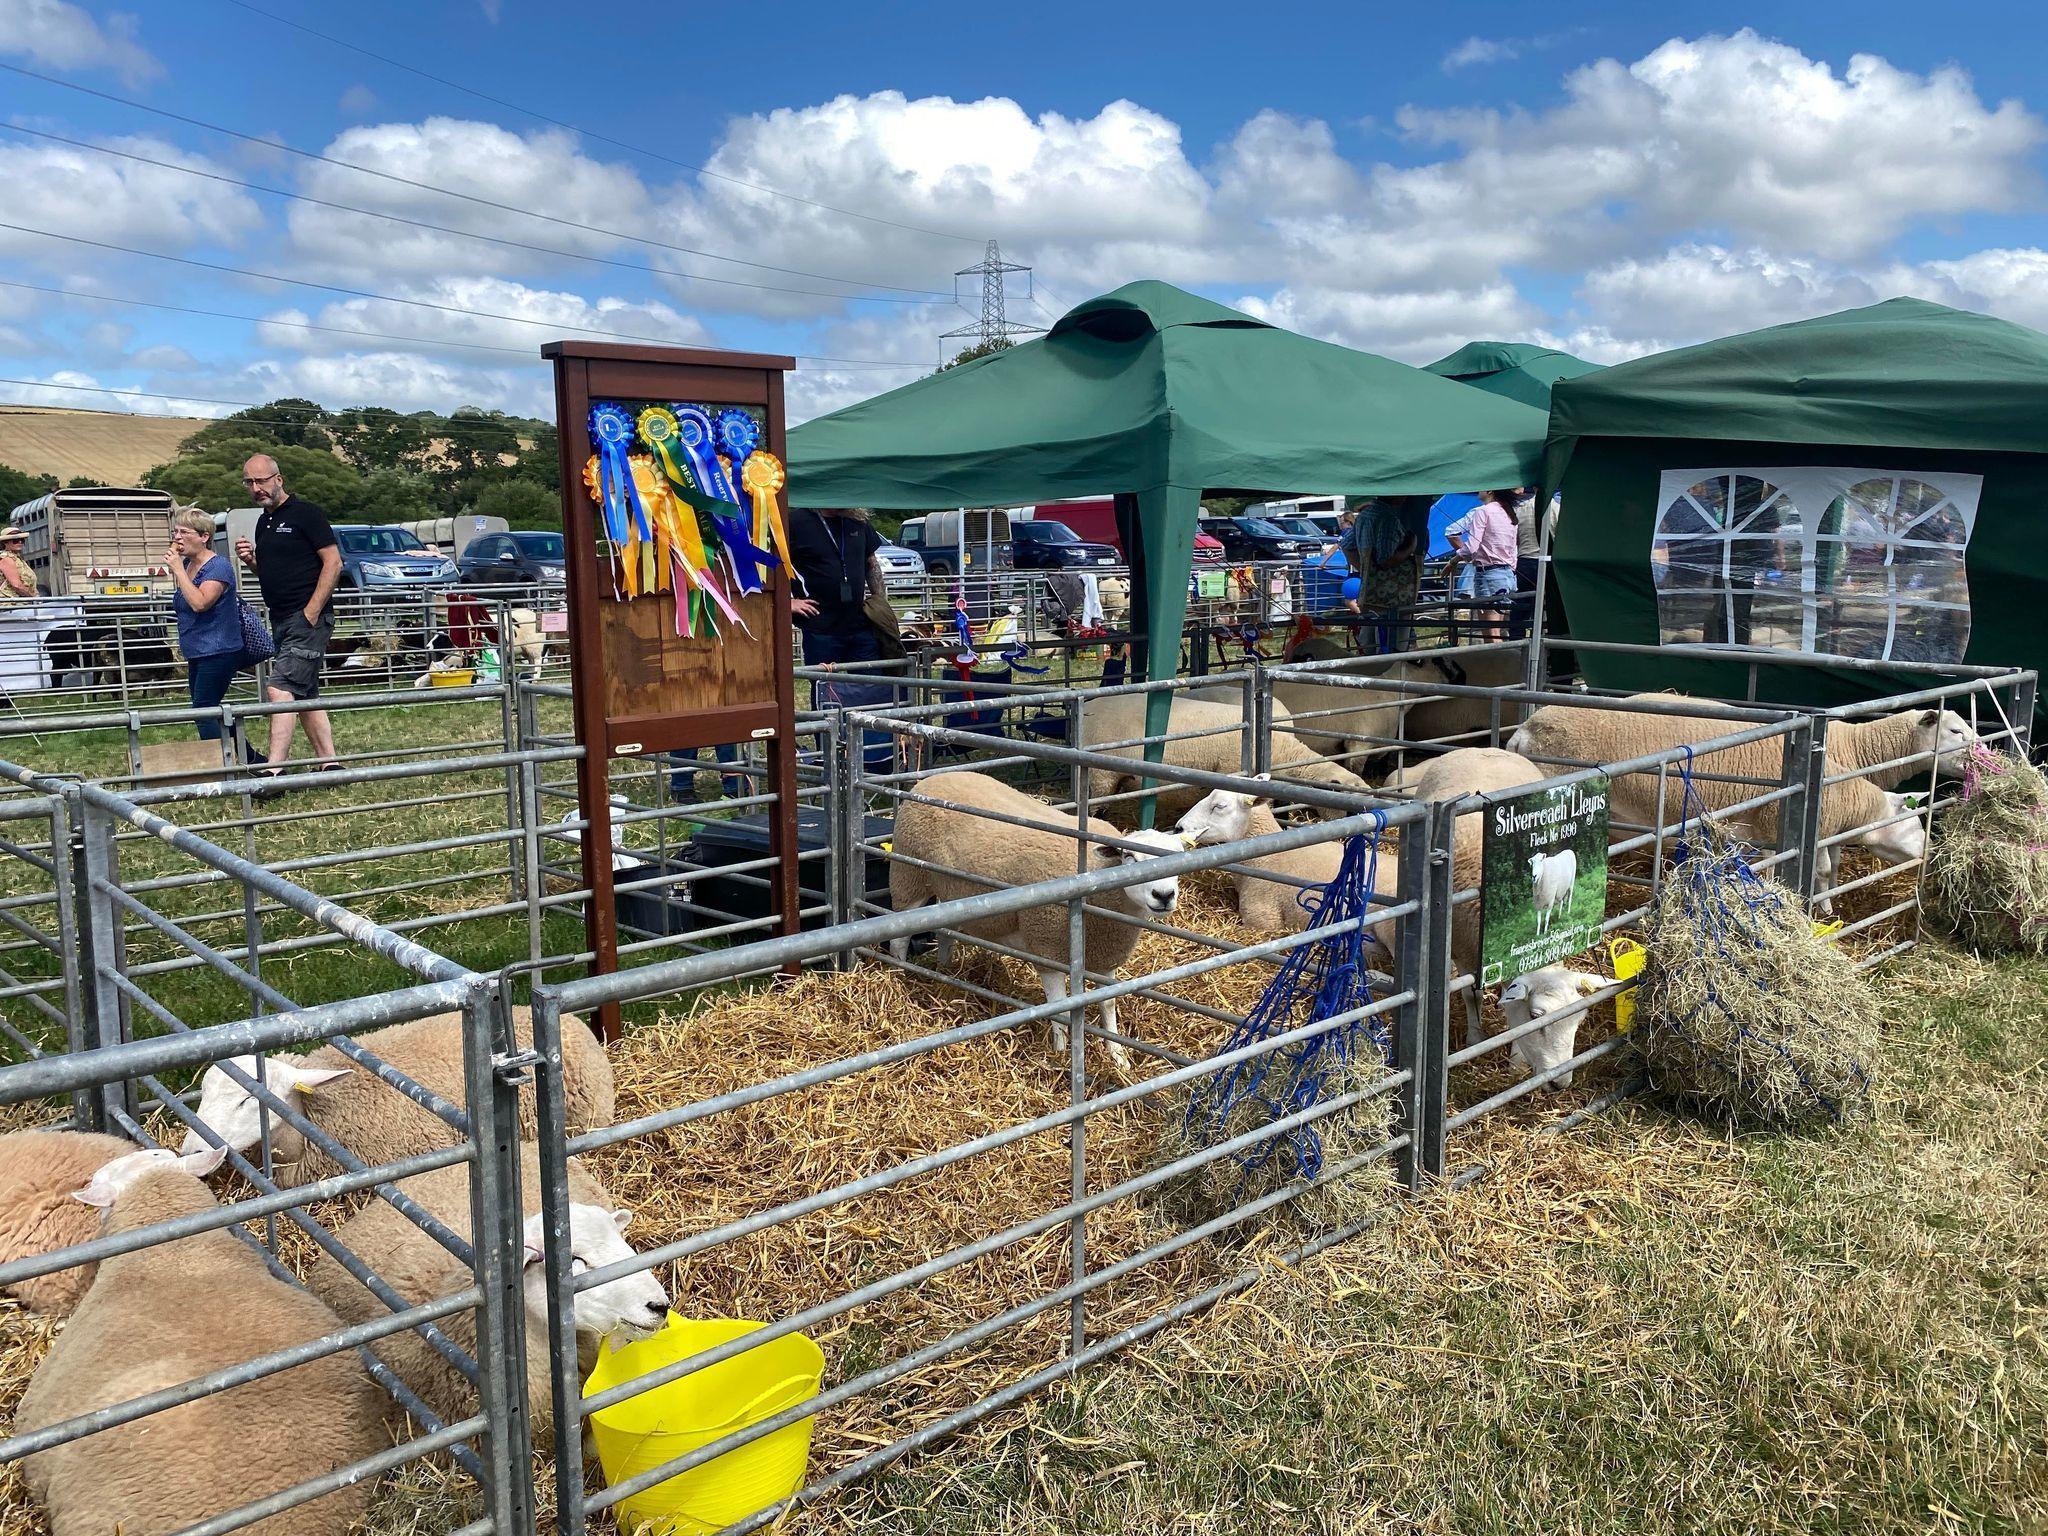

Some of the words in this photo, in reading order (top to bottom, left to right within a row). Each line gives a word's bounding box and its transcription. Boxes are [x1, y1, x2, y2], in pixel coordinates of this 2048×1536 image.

[680, 464, 696, 489] BEST
[713, 471, 729, 502] Reserv
[1571, 789, 1606, 826] Lleyns
[1530, 830, 1548, 848] Flock
[1549, 827, 1559, 843] No
[1560, 821, 1577, 840] 1990
[1518, 950, 1543, 973] 07544
